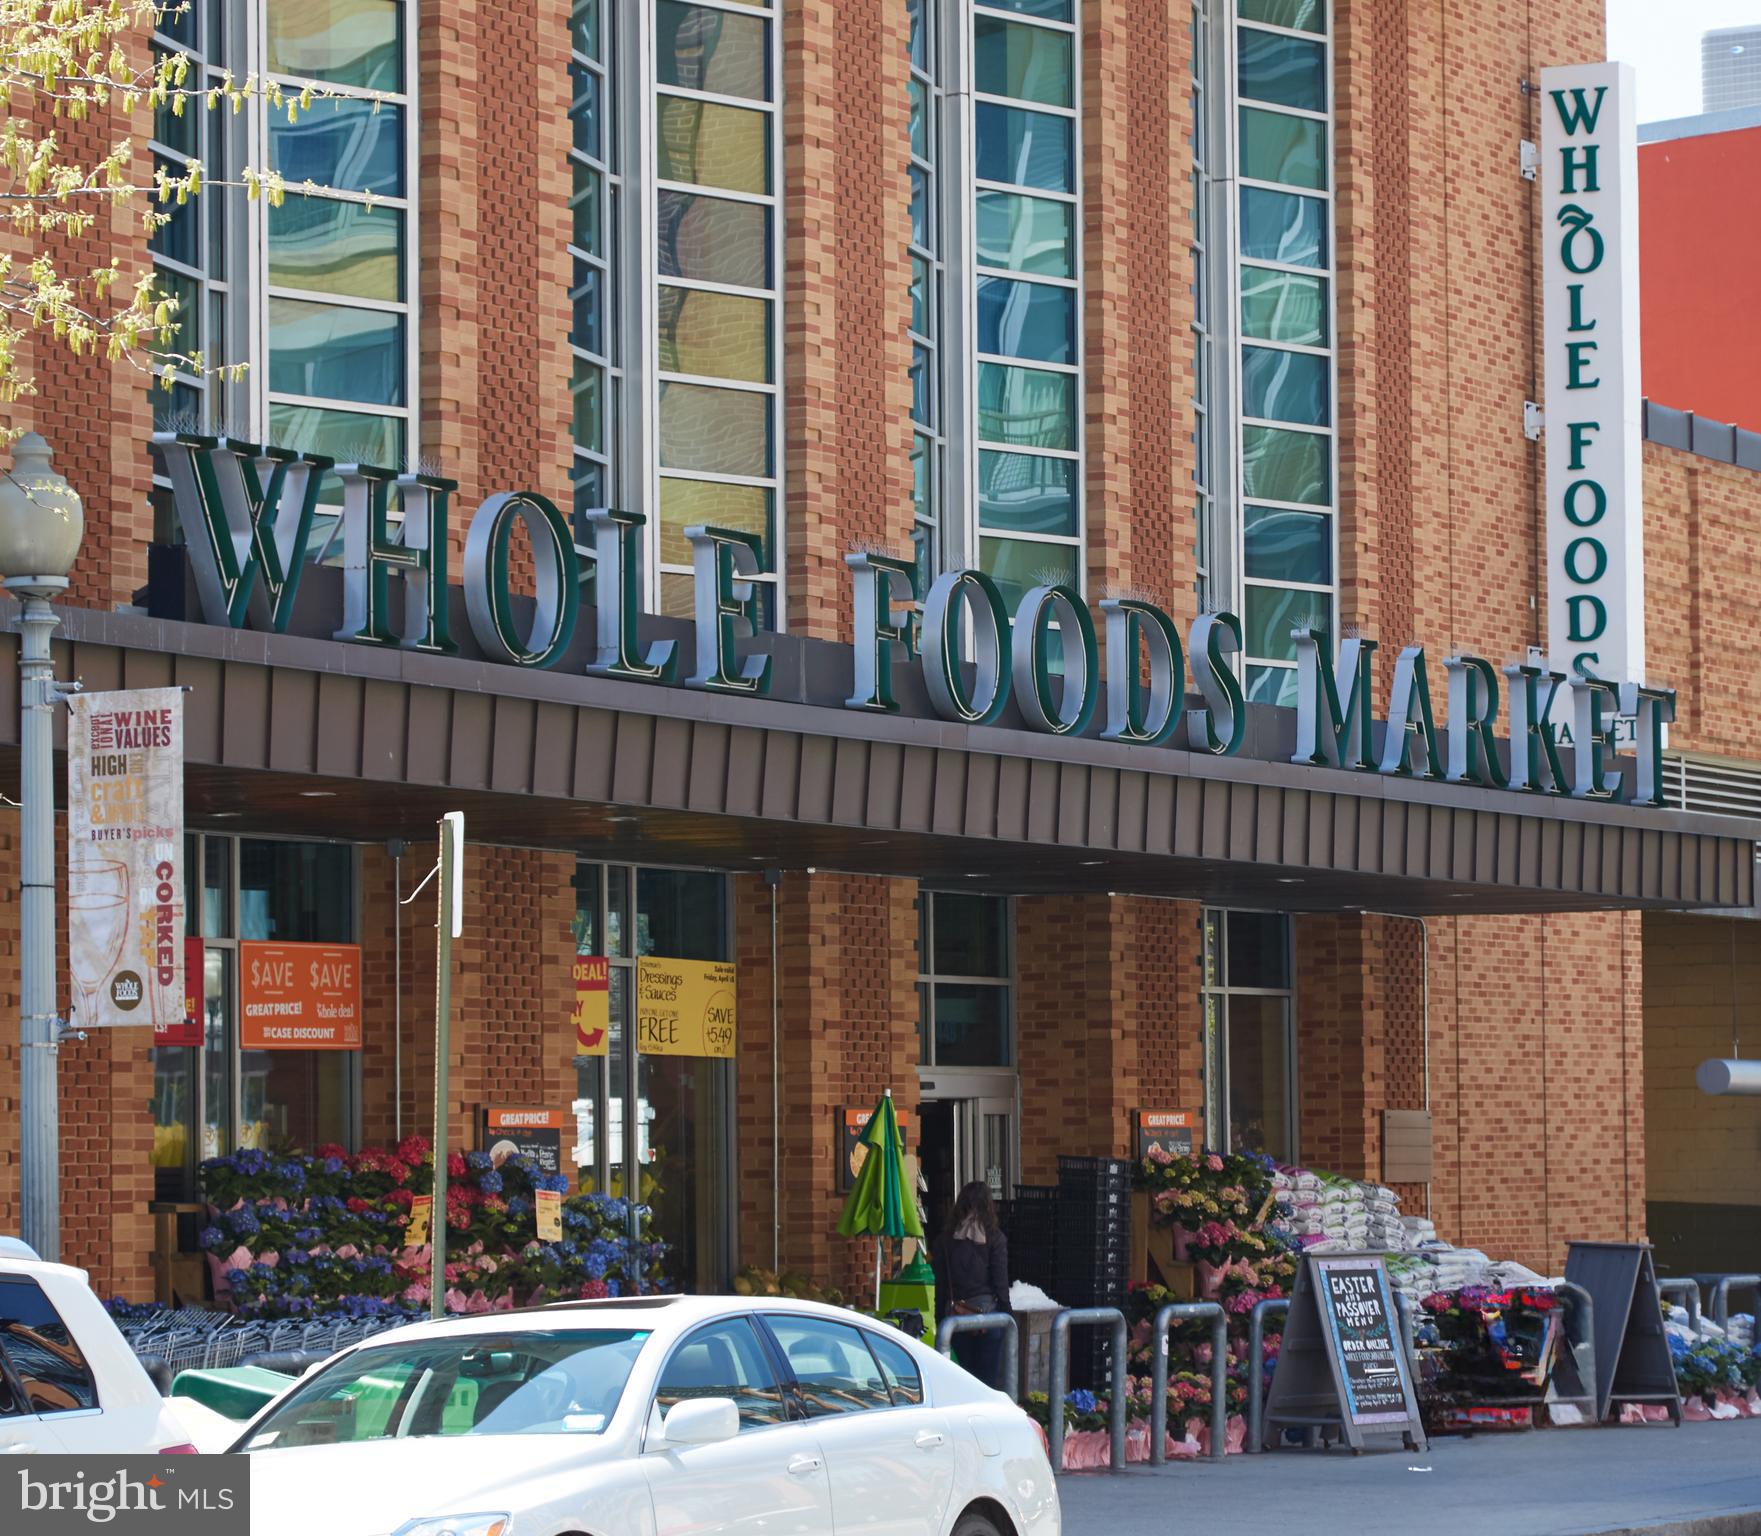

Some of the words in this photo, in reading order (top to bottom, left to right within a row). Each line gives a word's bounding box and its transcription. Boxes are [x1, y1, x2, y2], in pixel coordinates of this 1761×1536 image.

[1549, 86, 1608, 389] WHOLE
[152, 432, 773, 695] WHOLE
[845, 551, 1246, 757] FOODS
[1290, 628, 1677, 808] MARKET
[114, 709, 172, 728] WINE
[114, 726, 171, 749] VALUES
[91, 754, 127, 777] HIGH
[91, 774, 143, 801] craft
[91, 828, 132, 841] BUYER'S
[132, 826, 174, 842] picks
[156, 861, 174, 986] CORKED
[251, 959, 294, 989] $AVE
[310, 961, 352, 990] $AVE
[572, 962, 607, 981] DEAL!
[640, 968, 683, 989] Dressings
[646, 985, 677, 1002] Sauces
[246, 1003, 275, 1017] GREAT
[274, 1001, 303, 1015] PRICE!
[707, 1007, 734, 1025] SAVE
[271, 1027, 293, 1039] CASE
[294, 1027, 335, 1039] DISCOUNT
[640, 1017, 680, 1045] FREE
[500, 1113, 524, 1125] GREAT
[857, 1113, 872, 1124] GRE
[1148, 1115, 1165, 1125] GREAT
[1331, 1276, 1376, 1295] EASTER
[1335, 1299, 1381, 1318] PASSOVER
[1346, 1316, 1374, 1327] MENU
[1343, 1340, 1366, 1351] ORDER
[1366, 1338, 1390, 1350] ONLINE
